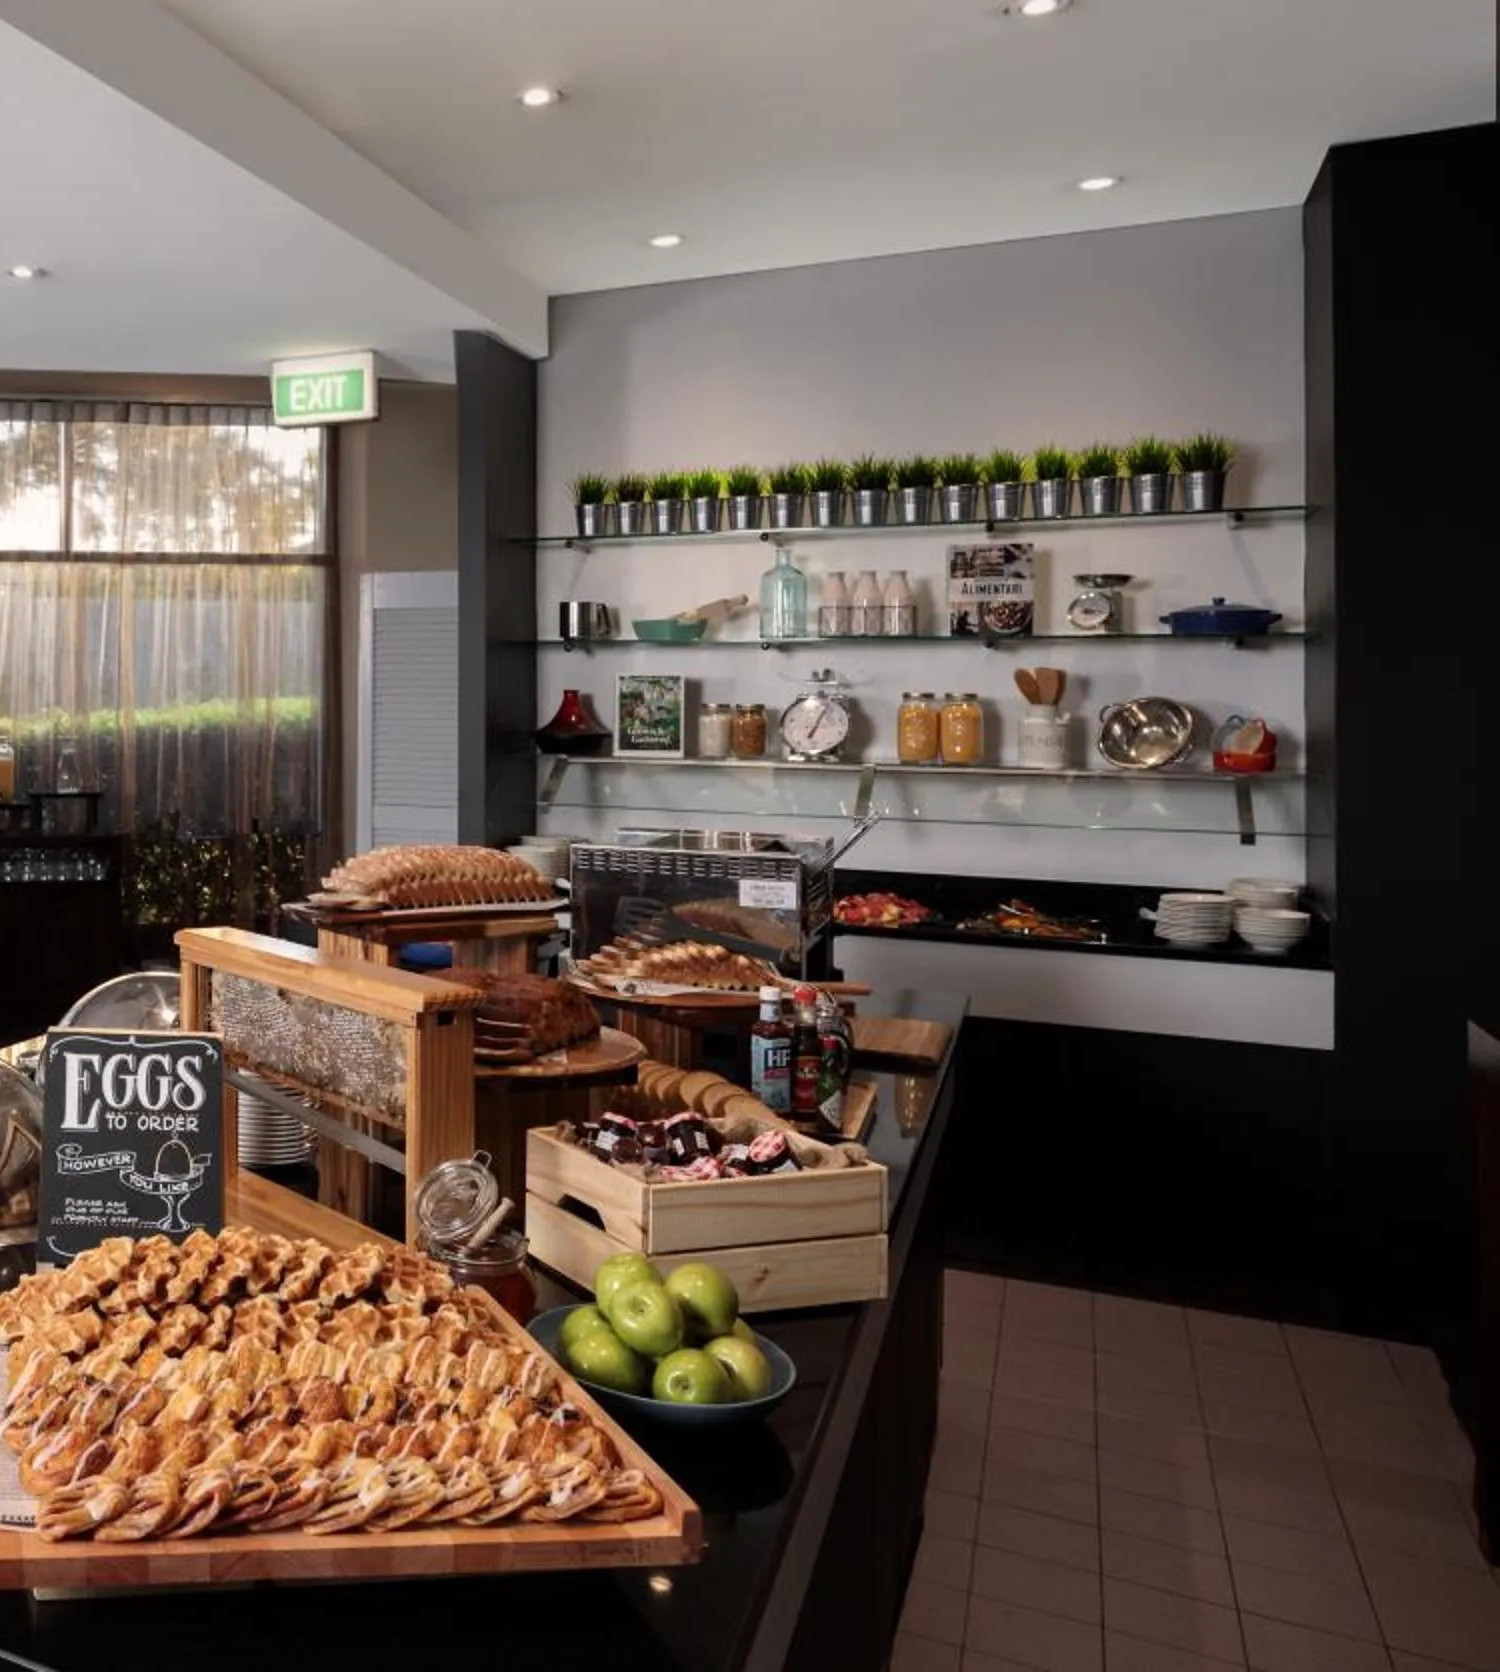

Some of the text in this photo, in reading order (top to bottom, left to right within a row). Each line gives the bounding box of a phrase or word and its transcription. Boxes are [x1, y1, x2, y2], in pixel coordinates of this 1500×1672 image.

[290, 376, 348, 412] EXIT
[961, 582, 1023, 596] ALIMENTARI
[60, 1051, 207, 1132] EGGS
[106, 1114, 199, 1132] TO ORDER
[63, 1154, 131, 1171] HOWEVER
[129, 1174, 189, 1193] YOU LIKE
